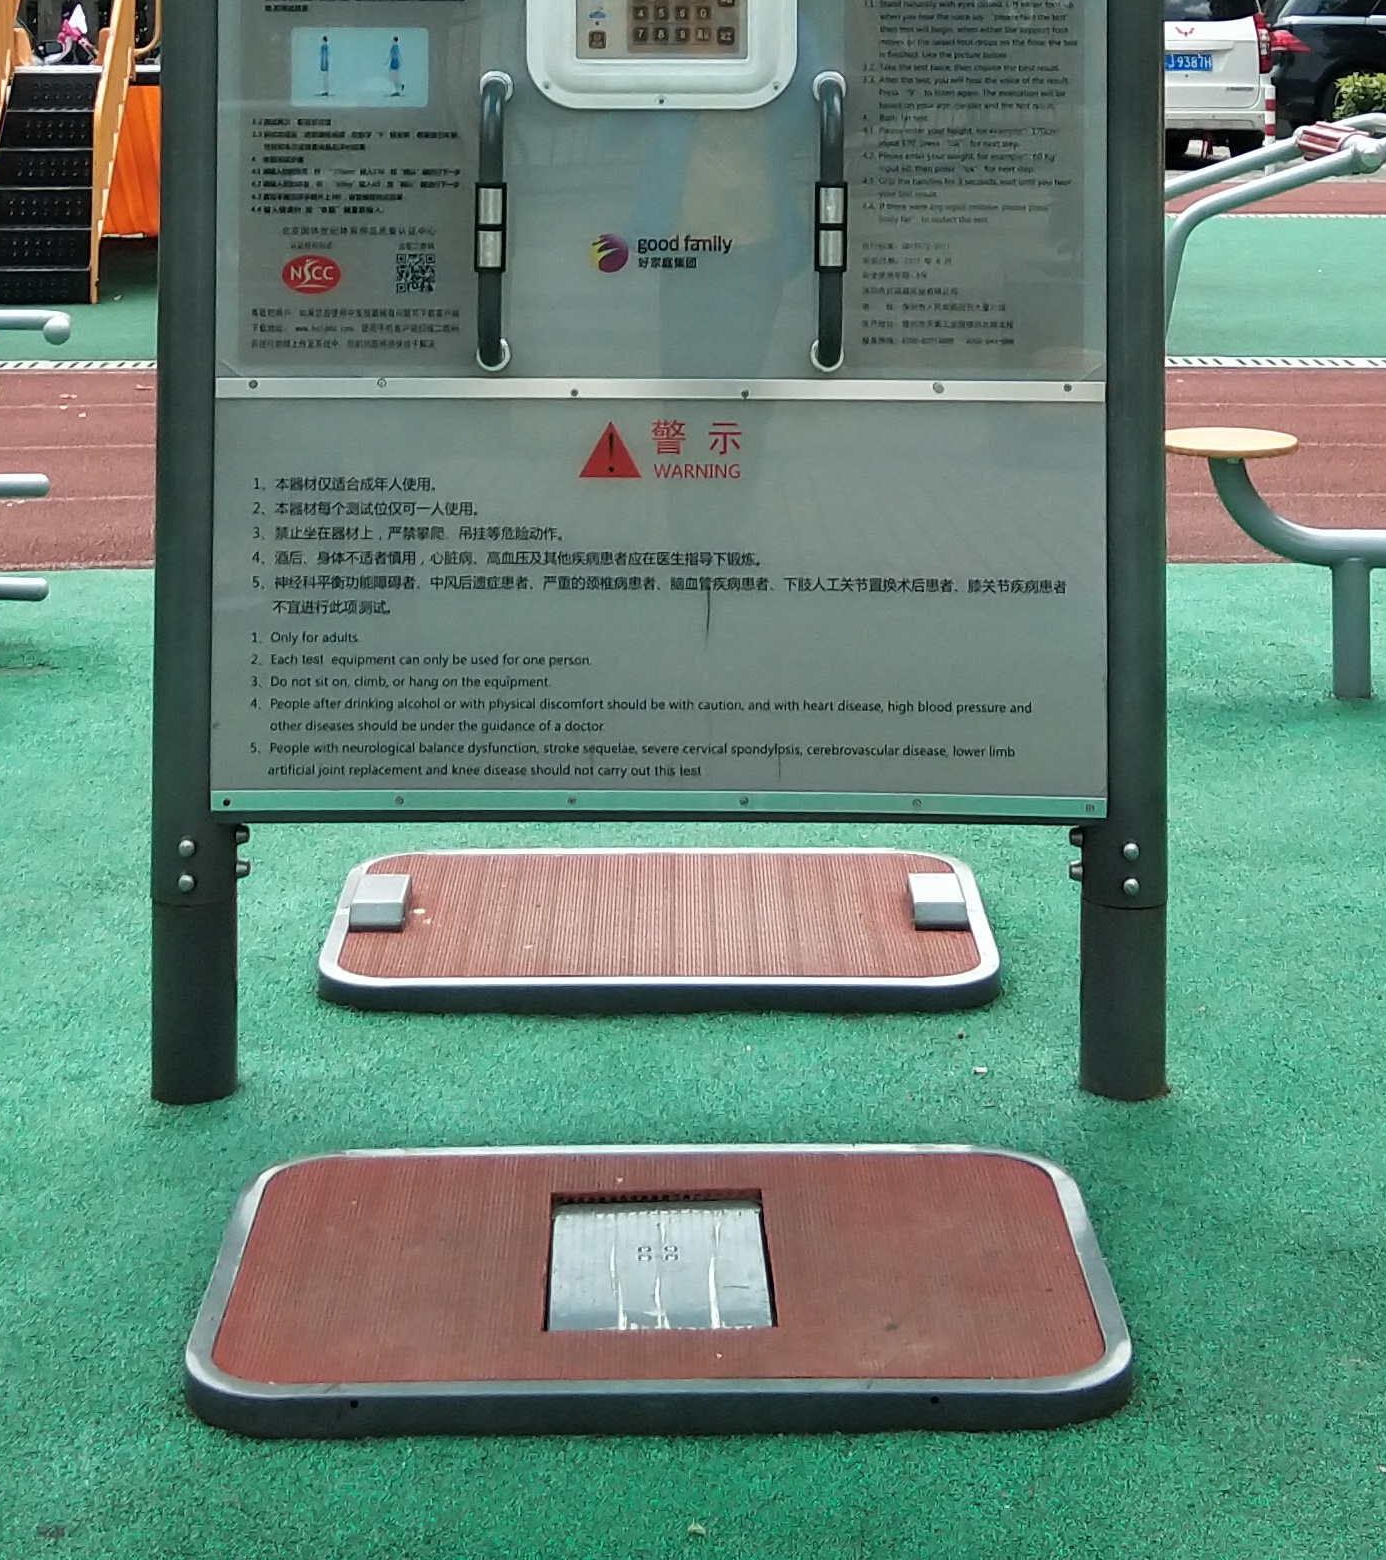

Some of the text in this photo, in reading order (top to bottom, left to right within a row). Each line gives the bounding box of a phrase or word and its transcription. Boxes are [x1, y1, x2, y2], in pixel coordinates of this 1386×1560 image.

[637, 233, 733, 254] good family
[637, 256, 697, 269] 好家庭集团
[651, 419, 742, 455] 警示
[653, 463, 741, 479] WARNING
[269, 631, 299, 647] Only
[301, 630, 319, 644] for
[270, 653, 299, 666] Each
[330, 653, 396, 668] equipment
[398, 655, 420, 666] can
[422, 652, 450, 669] only
[452, 653, 468, 666] be
[470, 653, 499, 666] used
[502, 652, 520, 667] for
[522, 655, 546, 666] one
[270, 675, 288, 688] Do
[291, 677, 312, 689] not
[314, 675, 329, 688] sit
[353, 674, 390, 689] climb,
[391, 677, 406, 688] or
[408, 675, 439, 691] hang
[441, 677, 458, 688] on
[461, 675, 481, 688] the
[270, 697, 311, 713] People
[312, 696, 342, 711] after
[343, 697, 394, 713] drinking
[397, 695, 441, 711] alcohol
[442, 700, 457, 710] or
[459, 697, 486, 710] with
[487, 697, 536, 713] physical
[539, 697, 605, 711] discomfort
[607, 697, 647, 711] should
[650, 697, 666, 711] be
[668, 697, 695, 711] with
[747, 698, 771, 712] and
[773, 699, 800, 712] with
[802, 699, 835, 712] heart
[887, 699, 914, 716] high
[917, 700, 953, 714] blood
[956, 703, 1007, 716] pressure
[1009, 701, 1033, 715] and
[269, 719, 303, 732] other
[304, 719, 355, 733] diseases
[357, 719, 398, 732] should
[401, 719, 417, 732] be
[419, 719, 456, 733] under
[458, 719, 478, 733] the
[480, 719, 536, 735] guidance
[538, 719, 552, 732] of
[554, 722, 562, 732] a
[268, 741, 311, 757] People
[313, 741, 339, 754] with
[341, 741, 416, 757] neurological
[418, 741, 465, 755] balance
[543, 741, 580, 755] stroke
[641, 744, 680, 756] severe
[681, 742, 728, 756] cervical
[806, 743, 901, 757] cerebrovascular
[952, 744, 987, 758] lower
[989, 744, 1016, 759] limb
[267, 763, 316, 777] artificial
[316, 763, 346, 779] joint
[348, 763, 423, 779] replacement
[425, 763, 448, 776] and
[451, 763, 481, 776] knee
[483, 763, 528, 777] disease
[530, 763, 571, 777] should
[574, 765, 595, 777] not
[597, 766, 628, 780] carry
[630, 765, 651, 777] out
[654, 764, 676, 778] this
